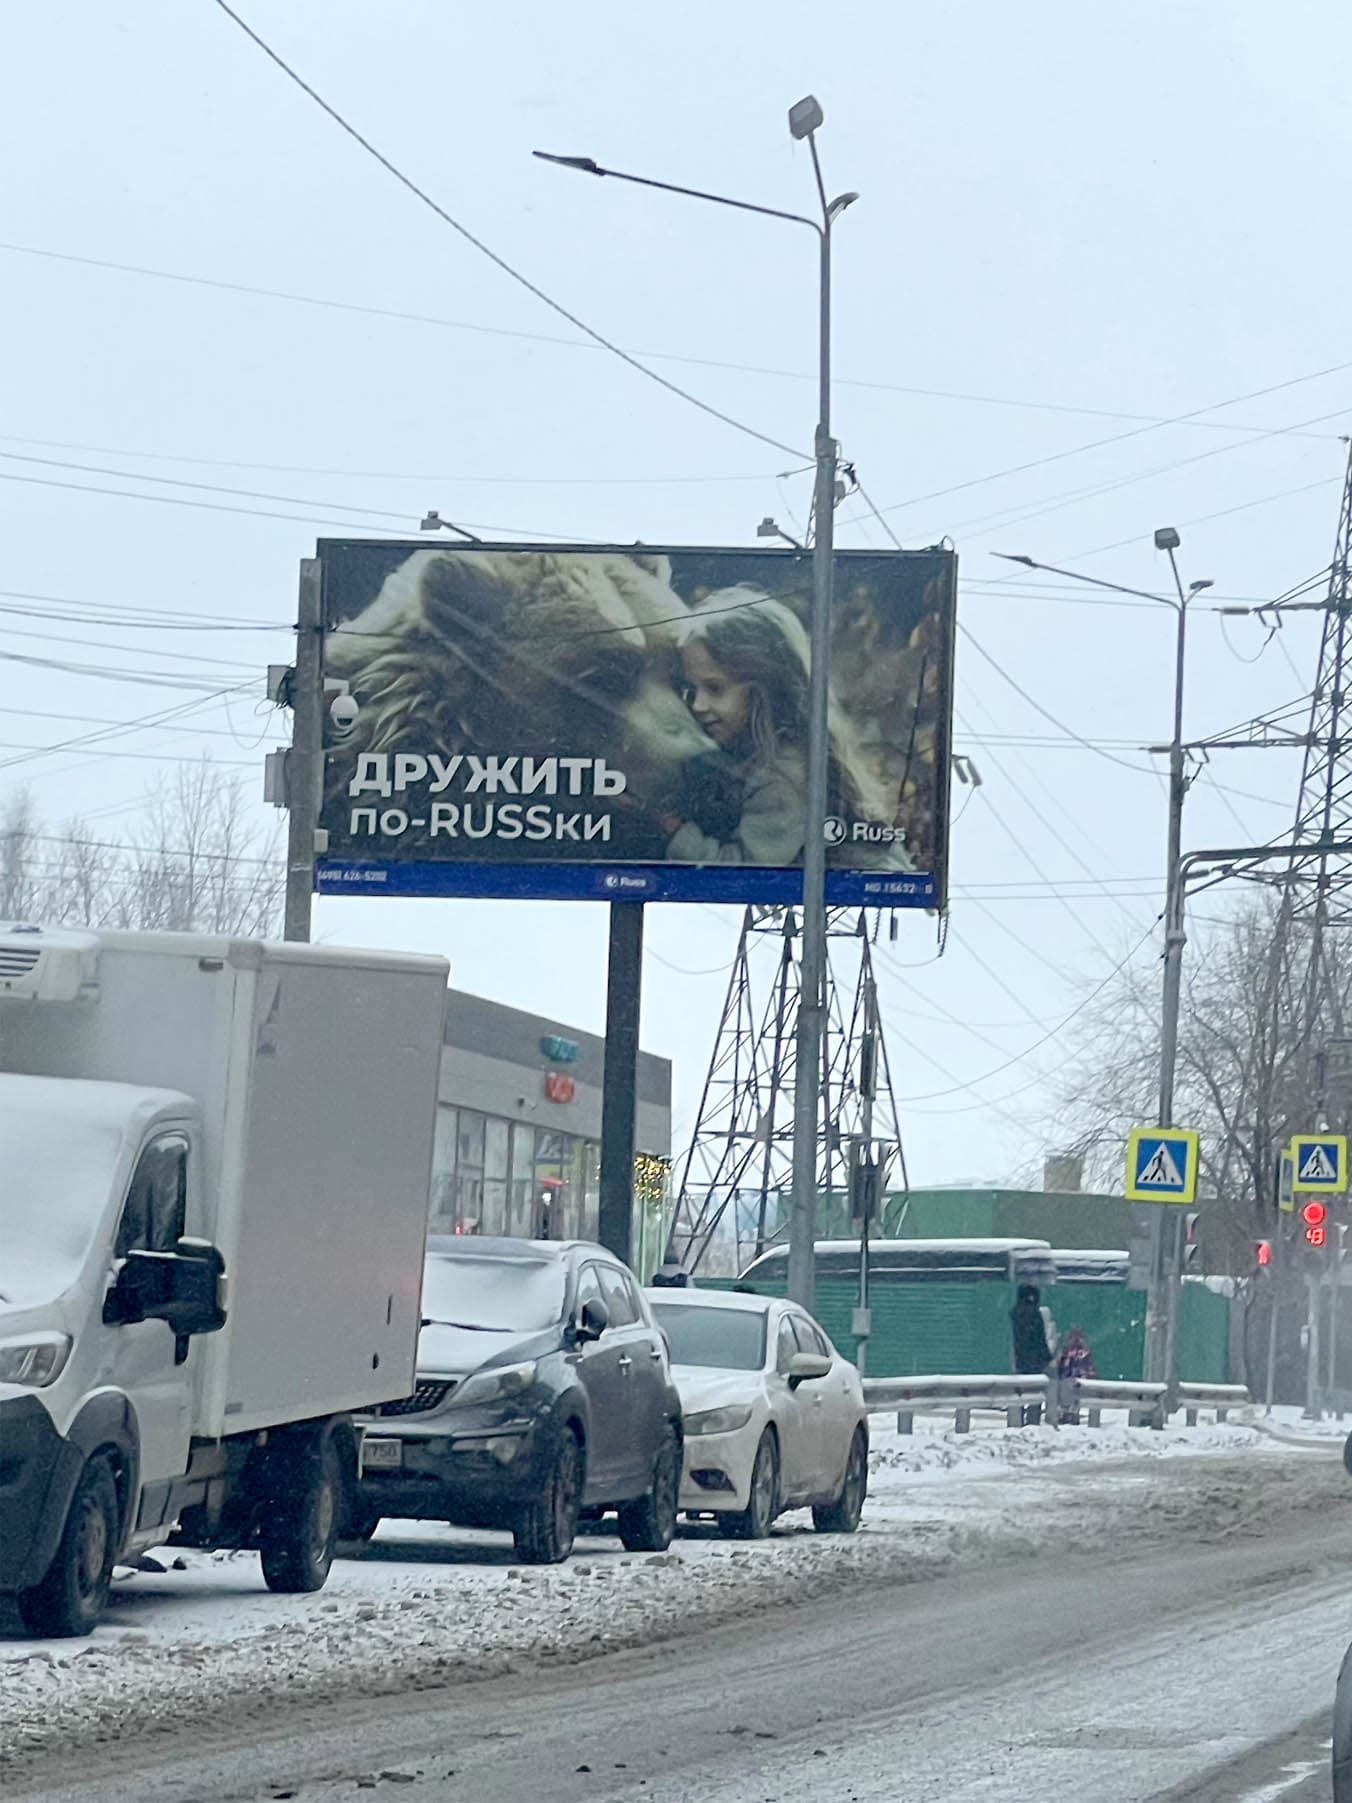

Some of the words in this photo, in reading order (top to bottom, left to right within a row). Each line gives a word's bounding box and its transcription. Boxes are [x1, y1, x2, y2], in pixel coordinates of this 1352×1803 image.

[349, 753, 627, 798] ДРУЖИТЬ
[350, 802, 611, 841] по-RUSSки
[853, 822, 906, 841] Russ
